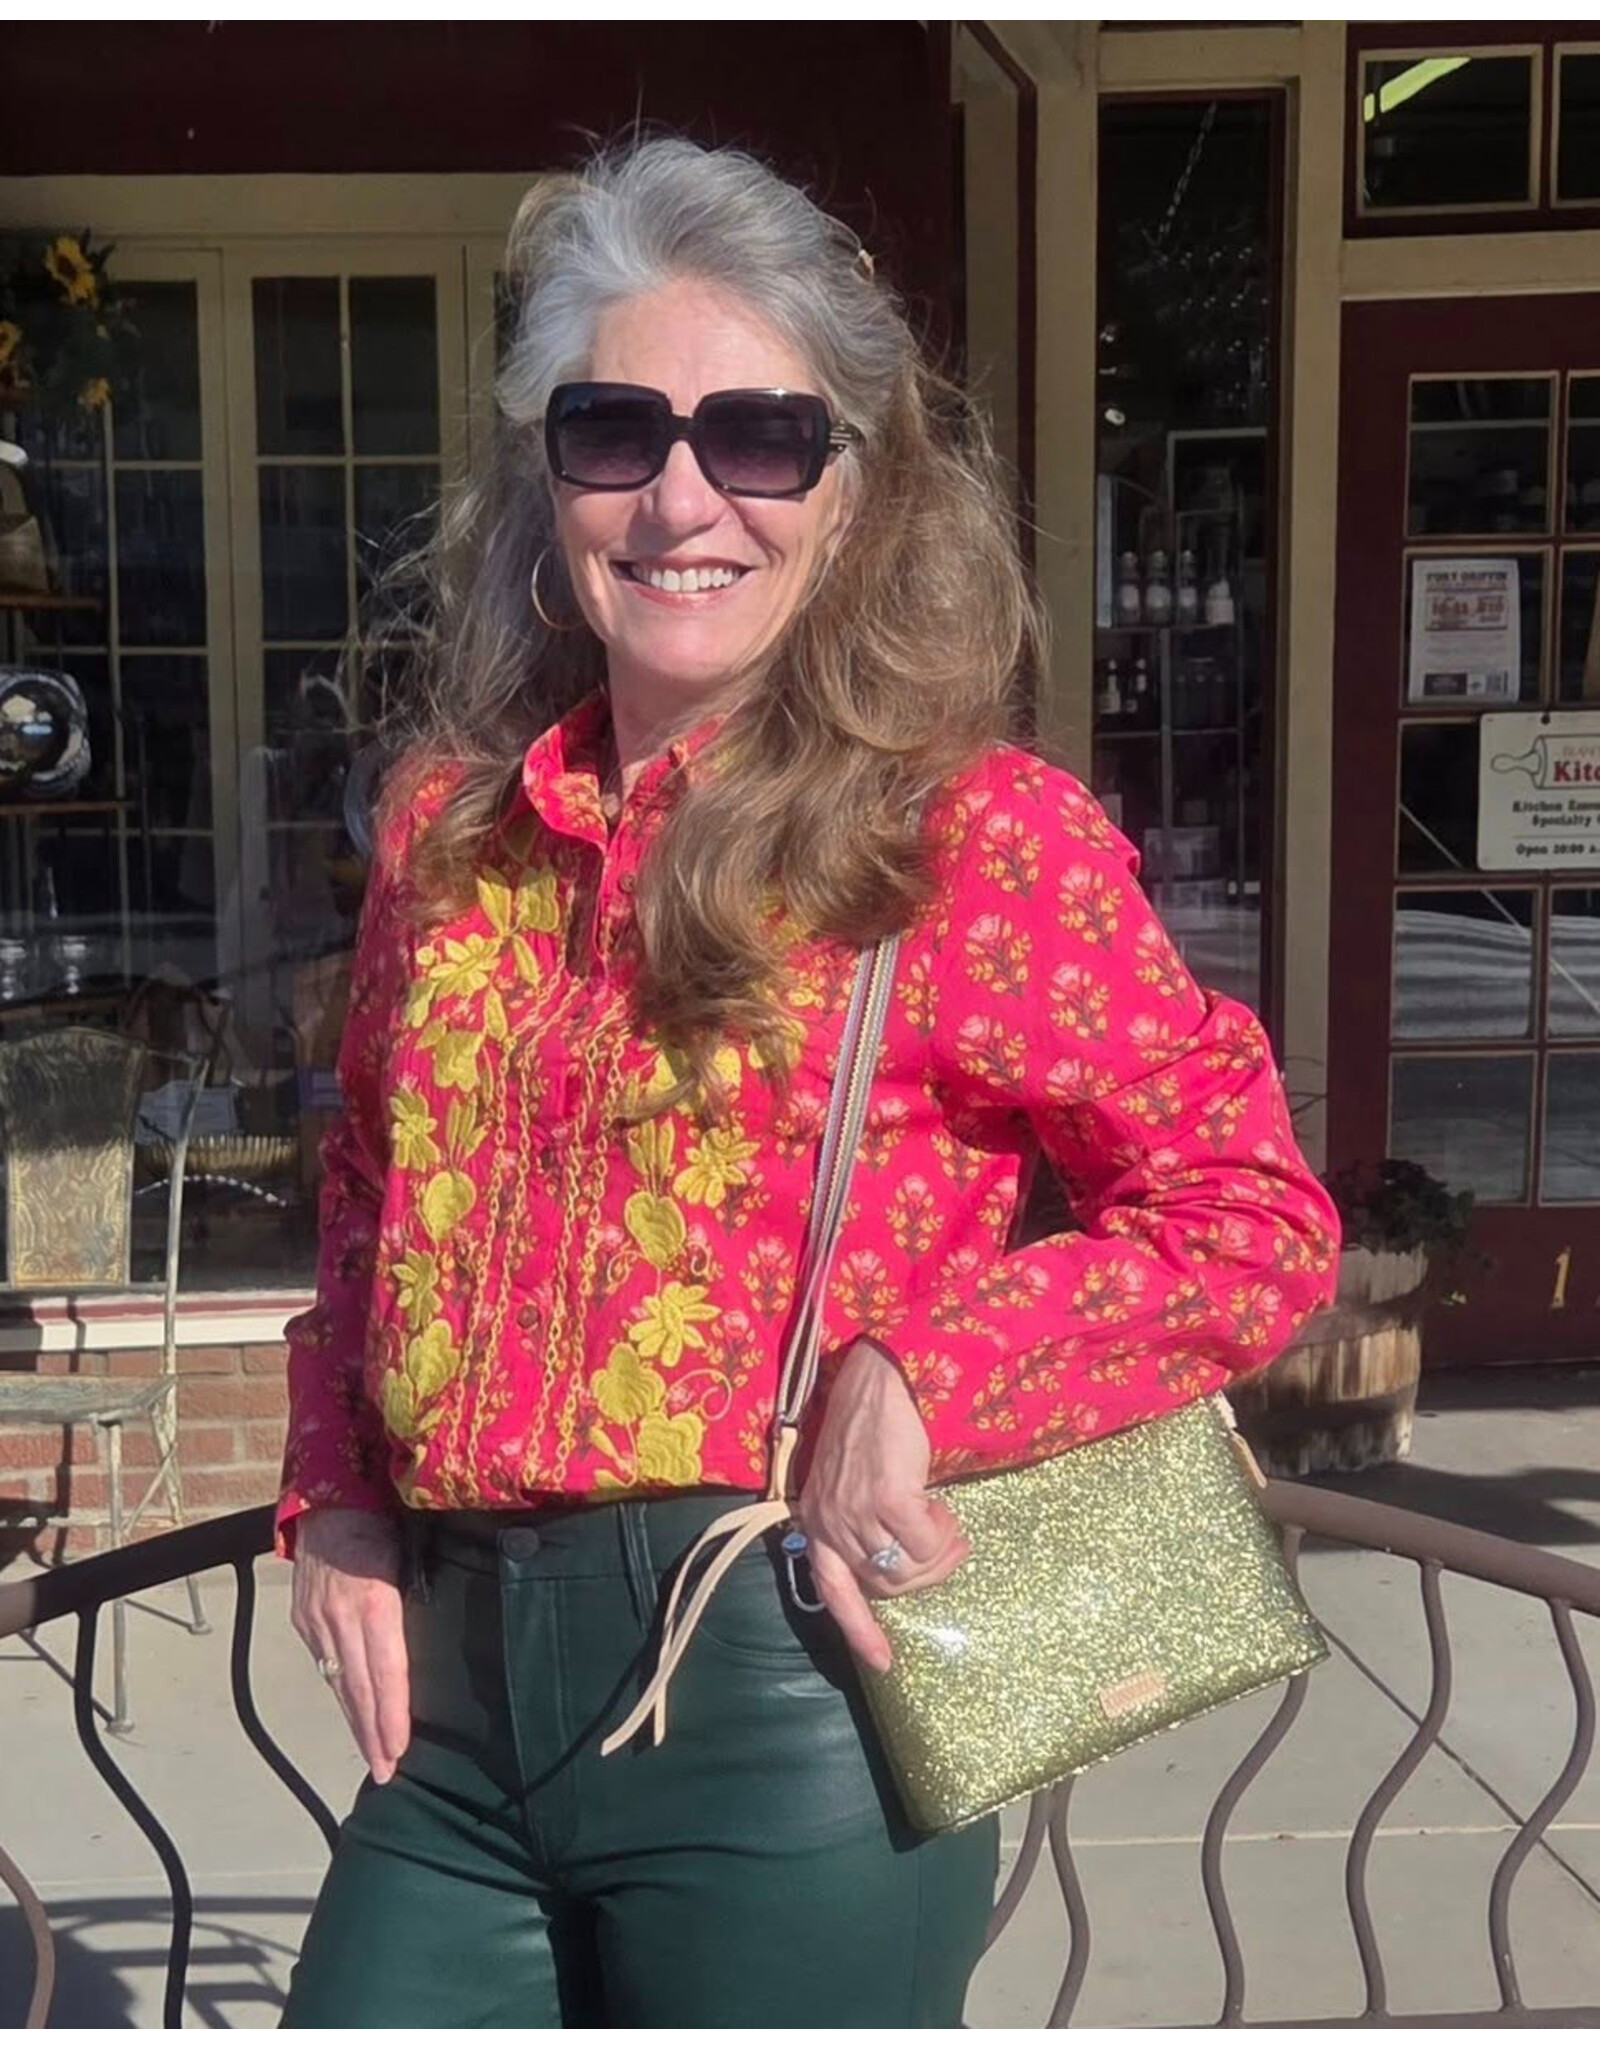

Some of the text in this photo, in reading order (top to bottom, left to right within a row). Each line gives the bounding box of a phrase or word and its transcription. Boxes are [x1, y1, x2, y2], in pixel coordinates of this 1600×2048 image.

[1512, 800, 1562, 813] Kitchen
[1532, 814, 1592, 828] Specialty
[1515, 843, 1548, 858] Open
[1551, 1245, 1571, 1308] 1
